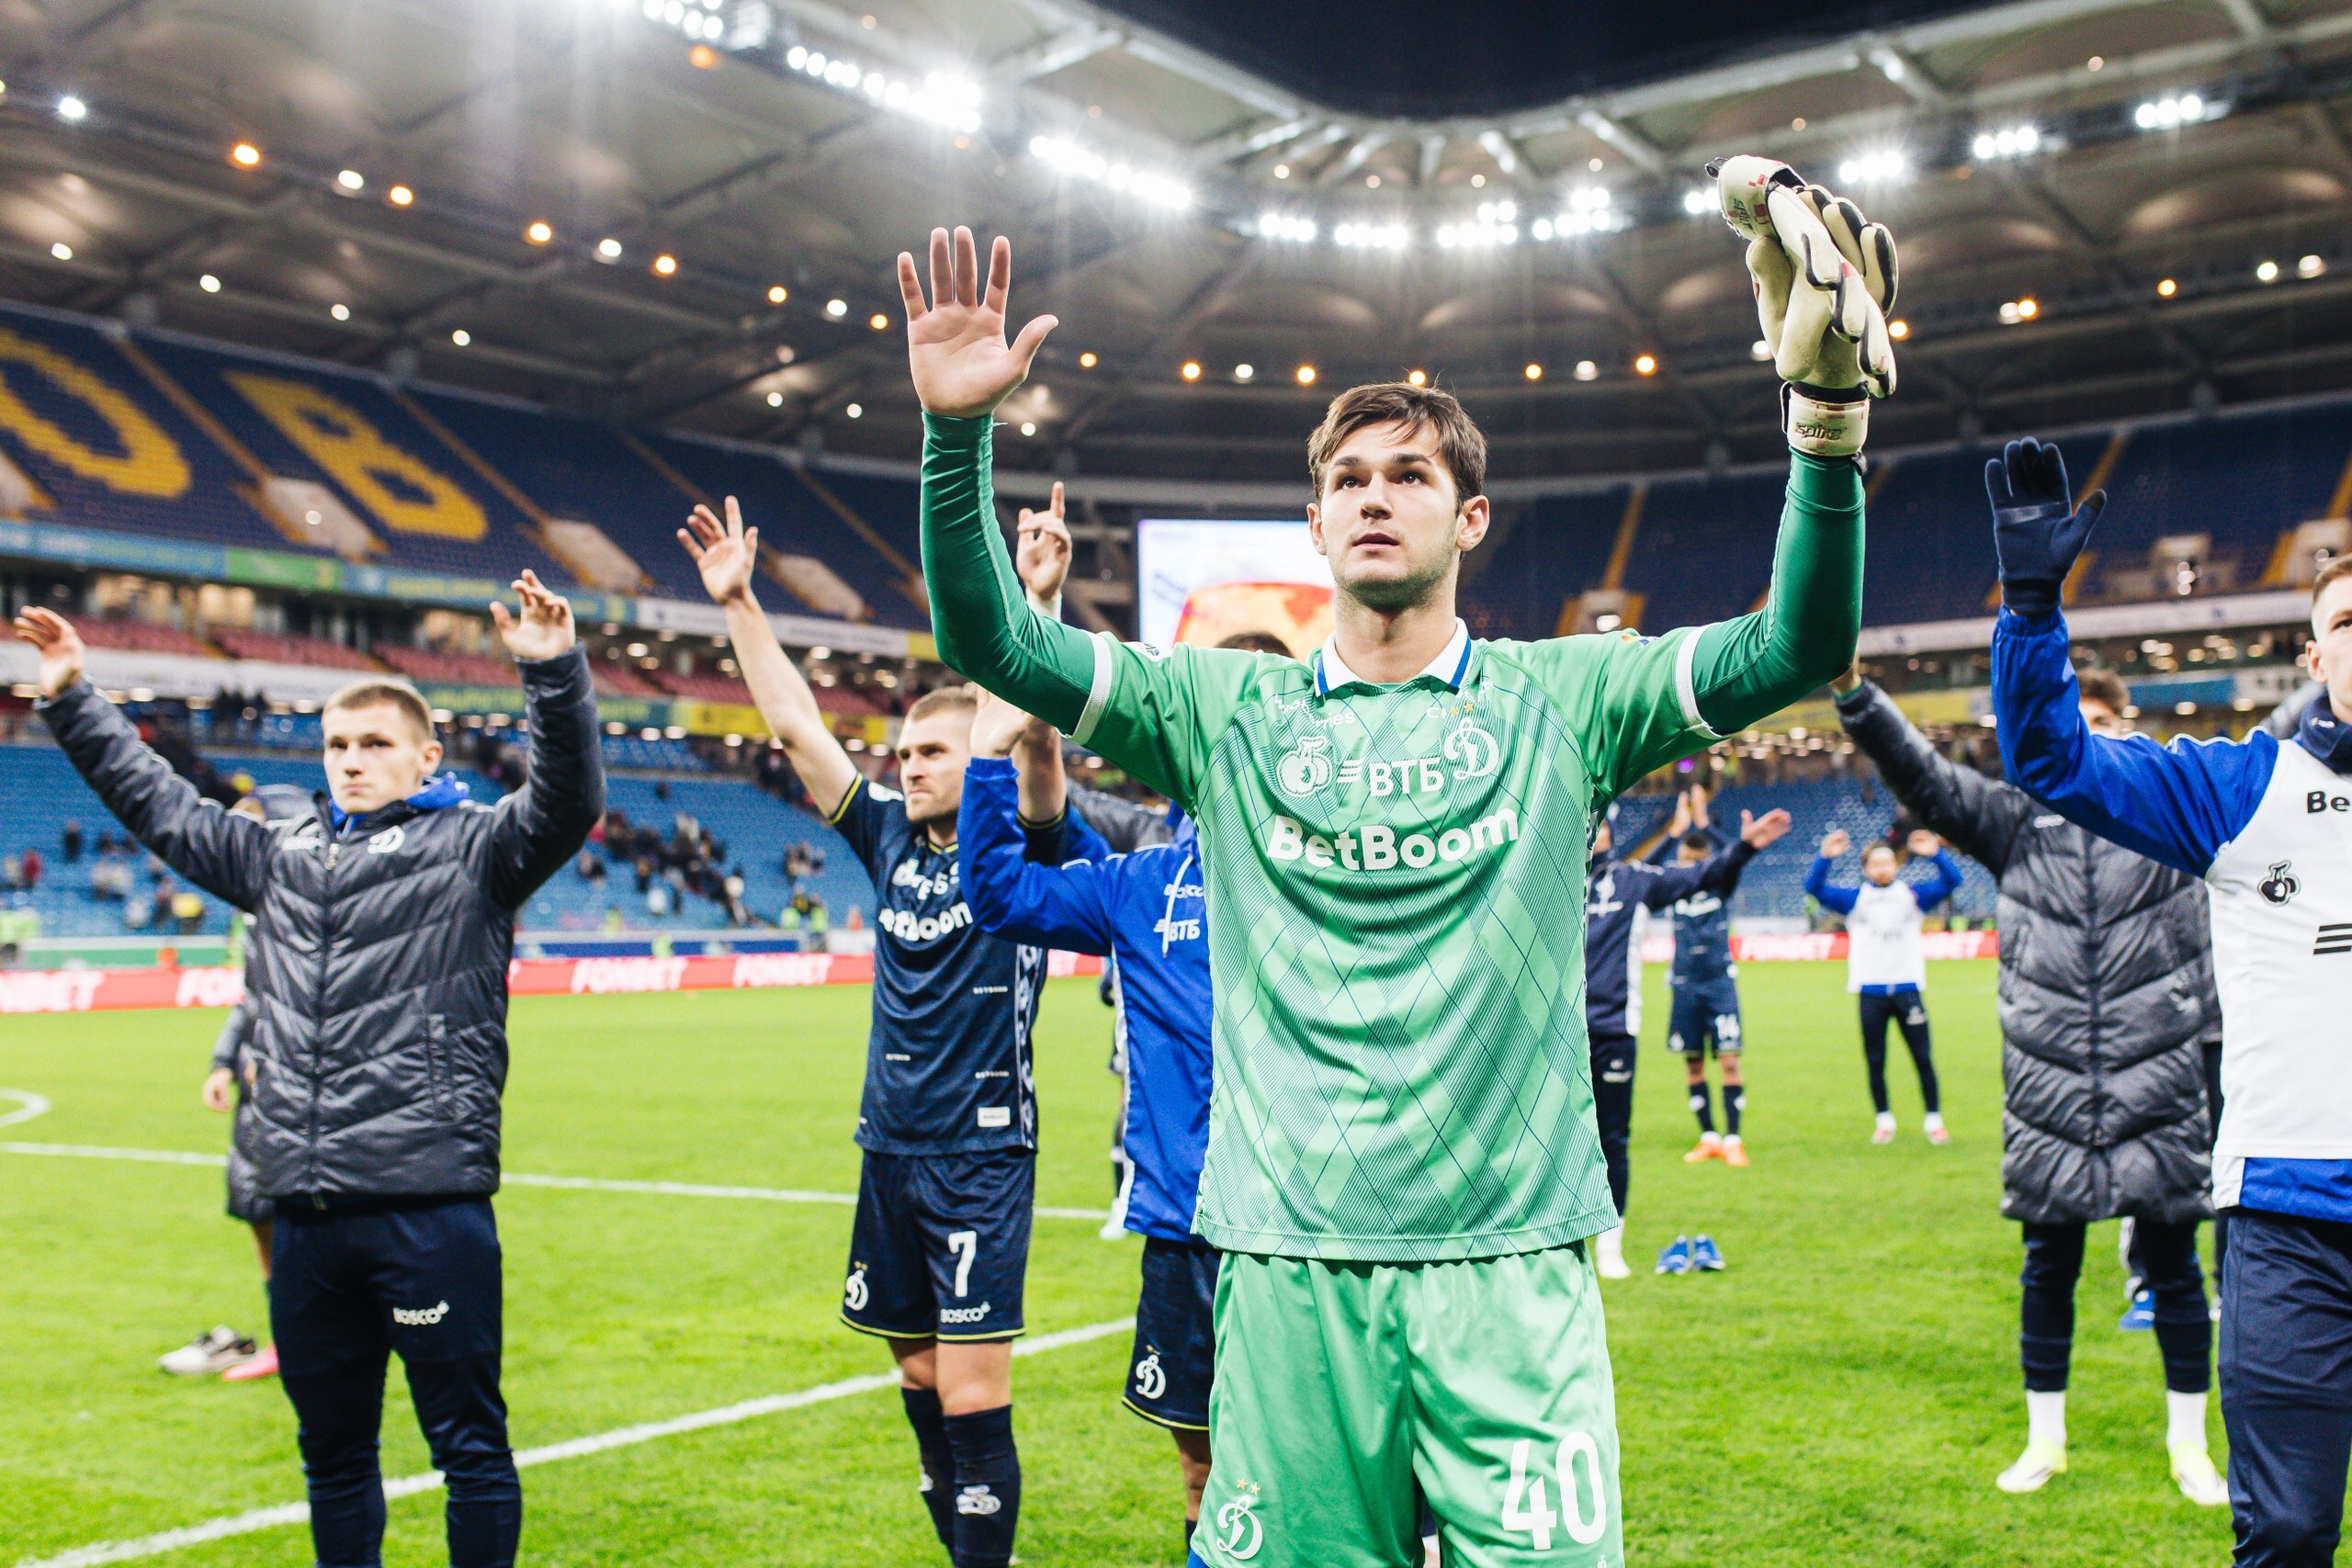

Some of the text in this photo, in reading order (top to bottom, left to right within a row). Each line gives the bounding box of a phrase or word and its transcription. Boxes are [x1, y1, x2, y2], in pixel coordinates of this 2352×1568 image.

[1369, 757, 1445, 797] ВТБ
[1267, 807, 1519, 871] BetBoom
[948, 1230, 978, 1298] 7
[1500, 1431, 1608, 1551] 40
